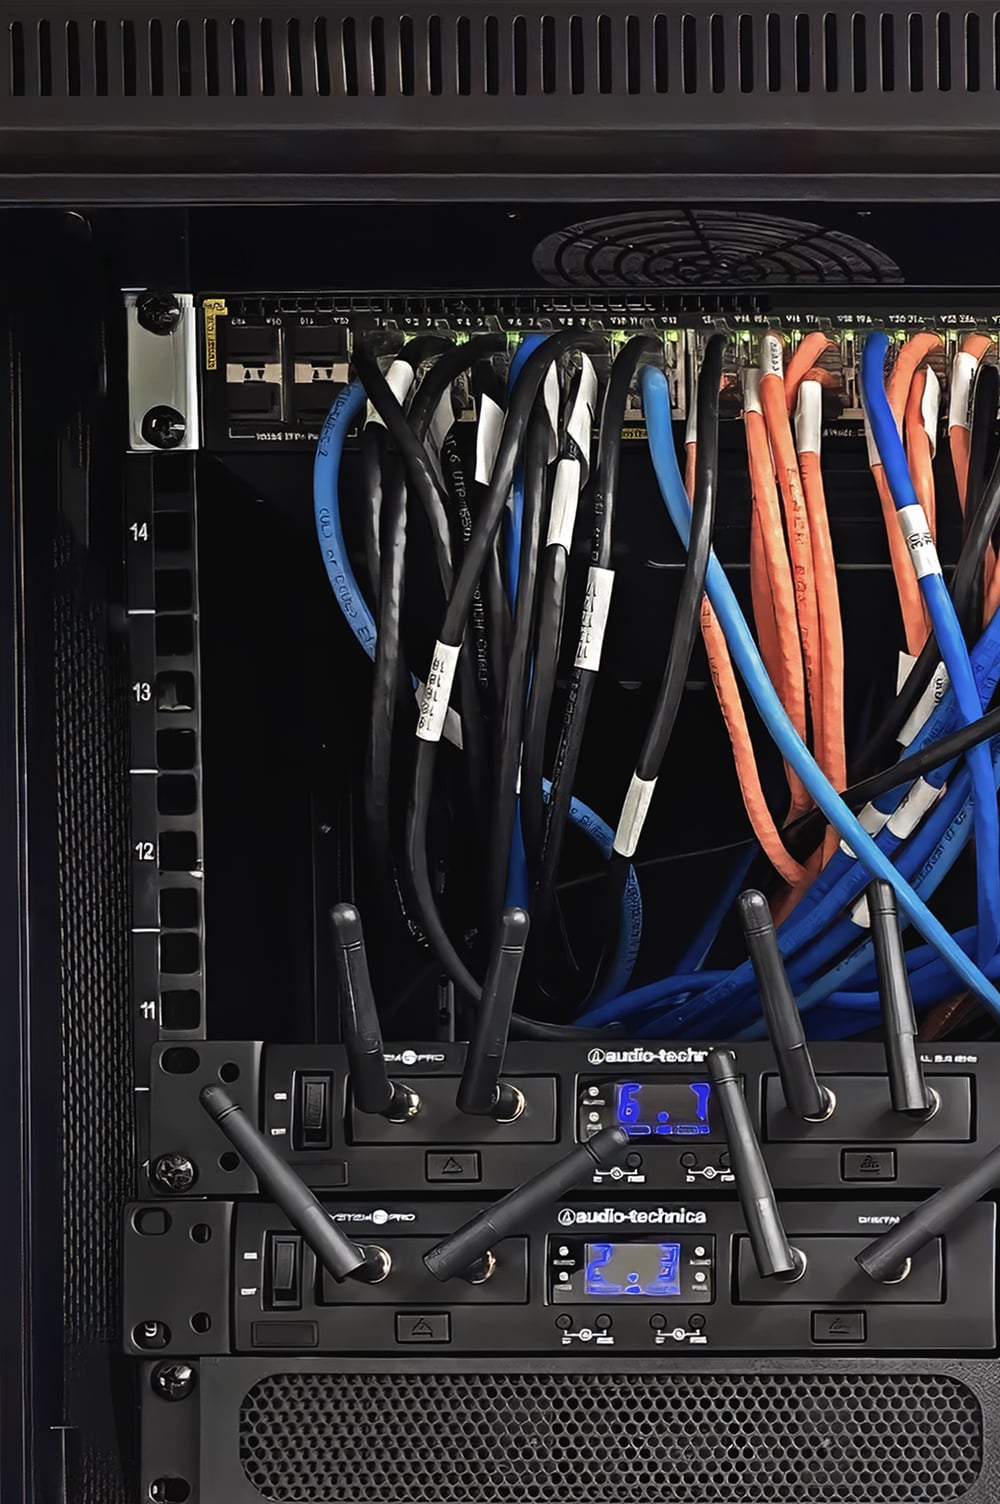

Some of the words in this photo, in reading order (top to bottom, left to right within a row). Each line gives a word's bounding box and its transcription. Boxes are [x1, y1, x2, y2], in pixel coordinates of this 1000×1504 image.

[129, 523, 149, 542] 14
[132, 682, 152, 701] 13
[134, 842, 154, 861] 12
[139, 1002, 156, 1020] 11
[575, 1207, 707, 1224] audio-technica
